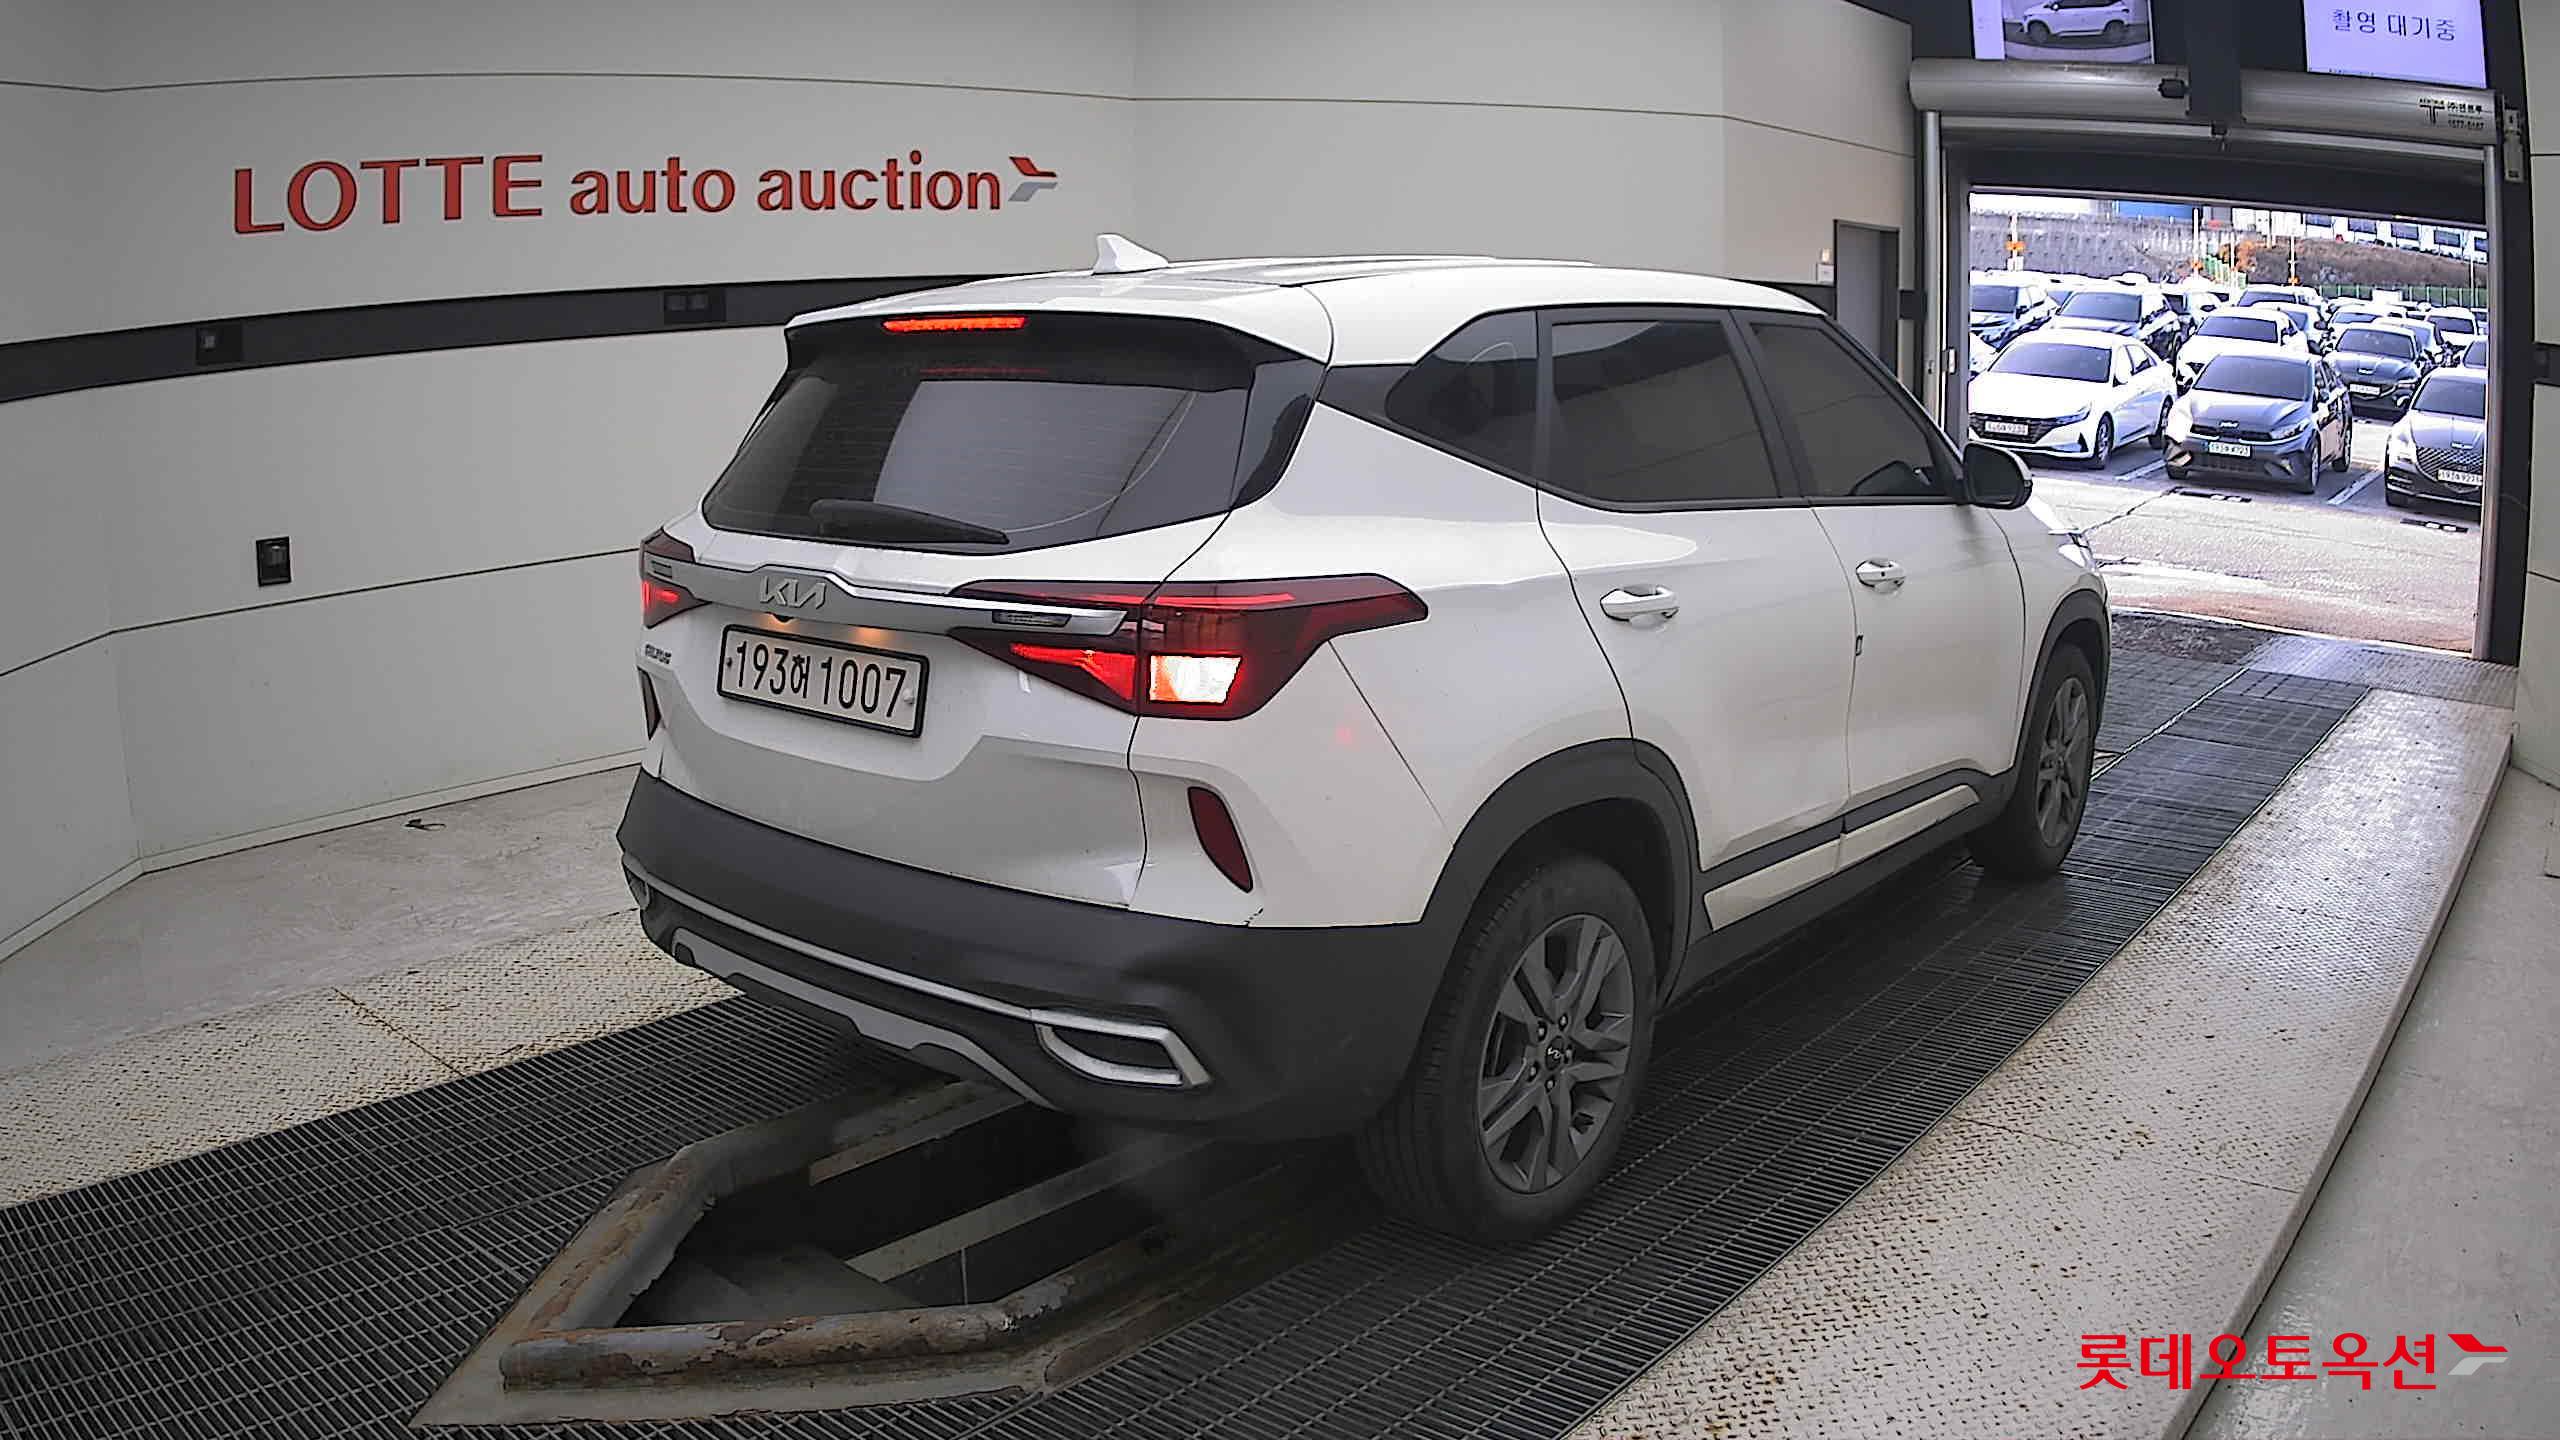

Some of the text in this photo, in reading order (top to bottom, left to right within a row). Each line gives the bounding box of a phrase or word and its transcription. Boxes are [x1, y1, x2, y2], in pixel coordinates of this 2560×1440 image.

[2333, 8, 2456, 42] 촬영 대기중
[233, 149, 1002, 235] LOTTE auto auction
[759, 575, 828, 611] KIA
[736, 640, 907, 718] 193허 1007
